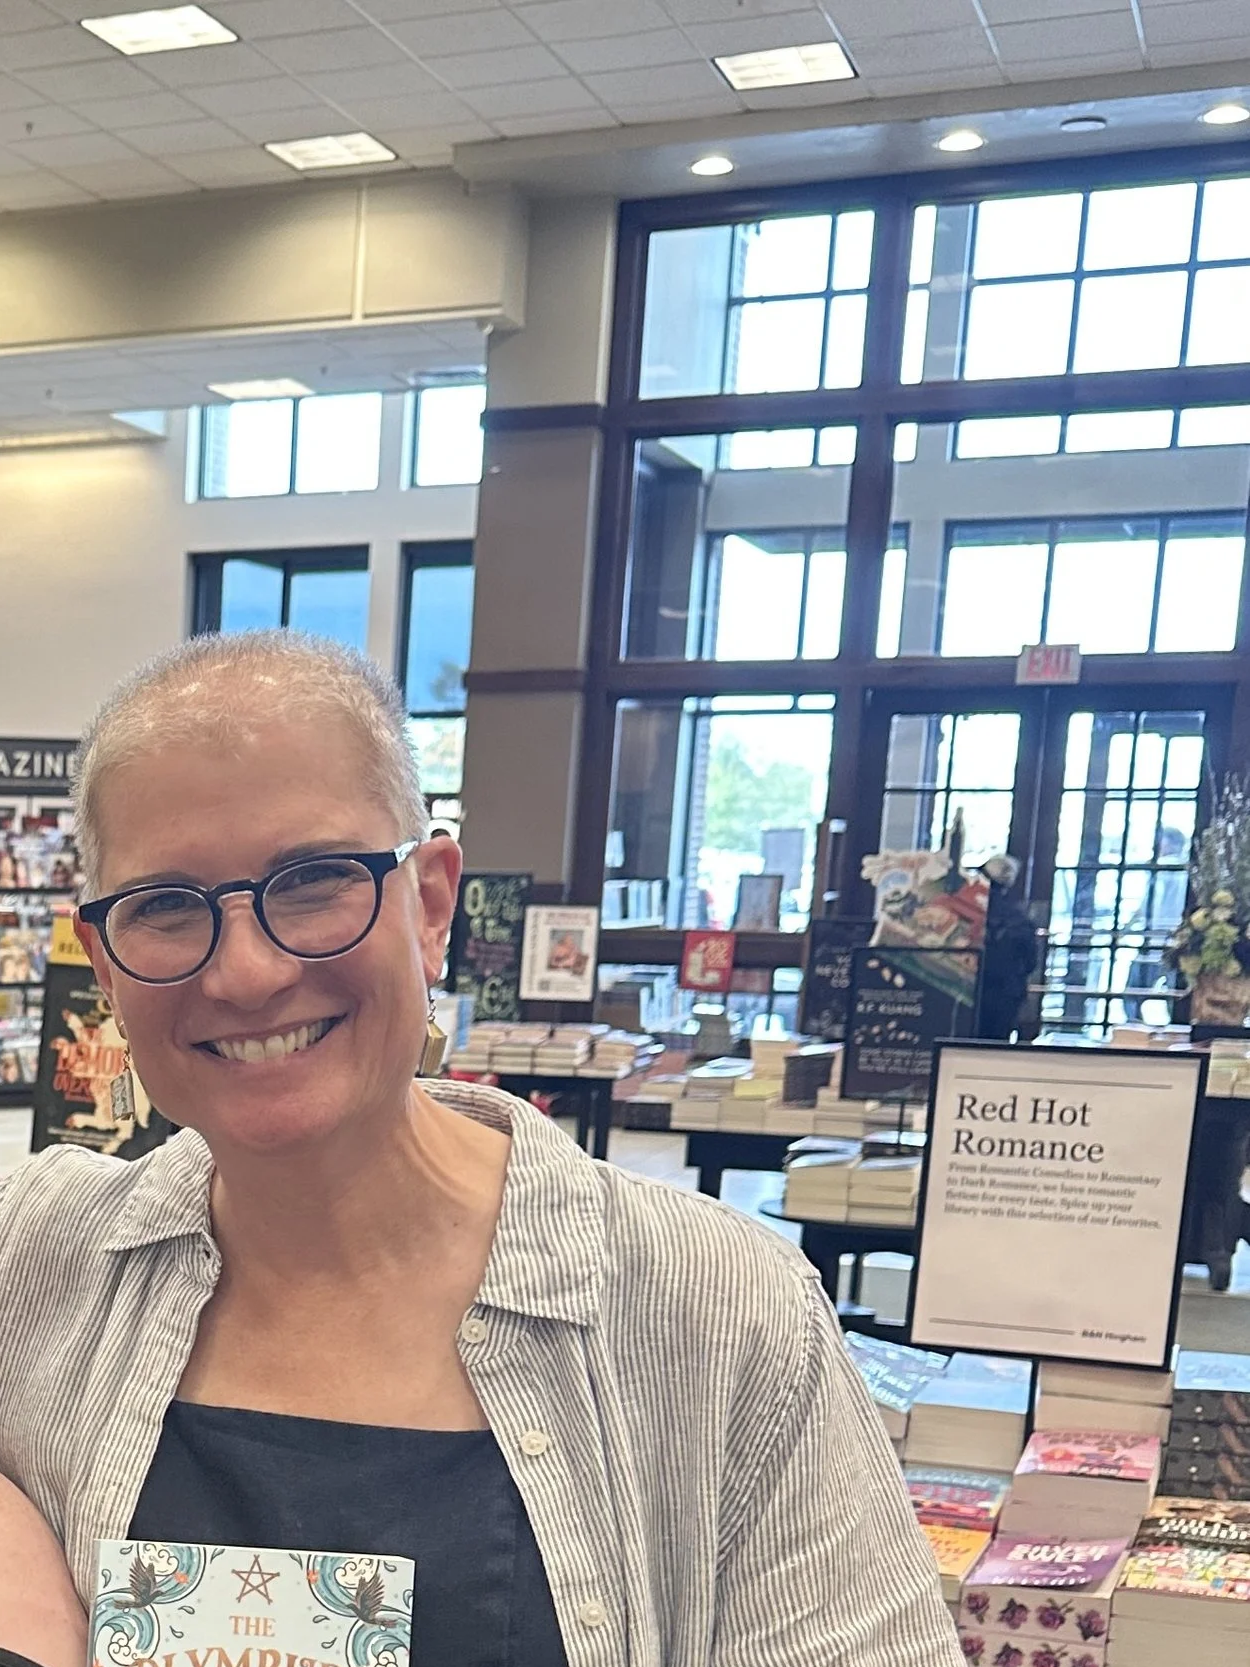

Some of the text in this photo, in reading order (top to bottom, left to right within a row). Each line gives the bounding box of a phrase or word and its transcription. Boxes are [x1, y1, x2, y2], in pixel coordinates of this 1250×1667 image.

[1026, 649, 1072, 680] EXIT
[956, 1093, 1092, 1127] Red Hot
[951, 1128, 1104, 1163] Romance
[949, 1162, 1162, 1187] From Romantic Comedies to Romantasy
[947, 1177, 958, 1186] to
[961, 1177, 985, 1188] Dark
[1043, 1184, 1057, 1192] we
[1060, 1183, 1085, 1194] have
[1087, 1186, 1137, 1198] romantic
[944, 1203, 978, 1216] library
[981, 1205, 1004, 1216] with
[1006, 1206, 1027, 1218] this
[1029, 1209, 1075, 1222] selection
[1077, 1212, 1089, 1224] of
[1090, 1216, 1109, 1225] our
[981, 1191, 997, 1202] for
[999, 1195, 1028, 1206] every
[1060, 1197, 1089, 1210] Spice
[1092, 1202, 1105, 1212] up
[1108, 1203, 1133, 1213] your
[230, 1615, 275, 1638] THE
